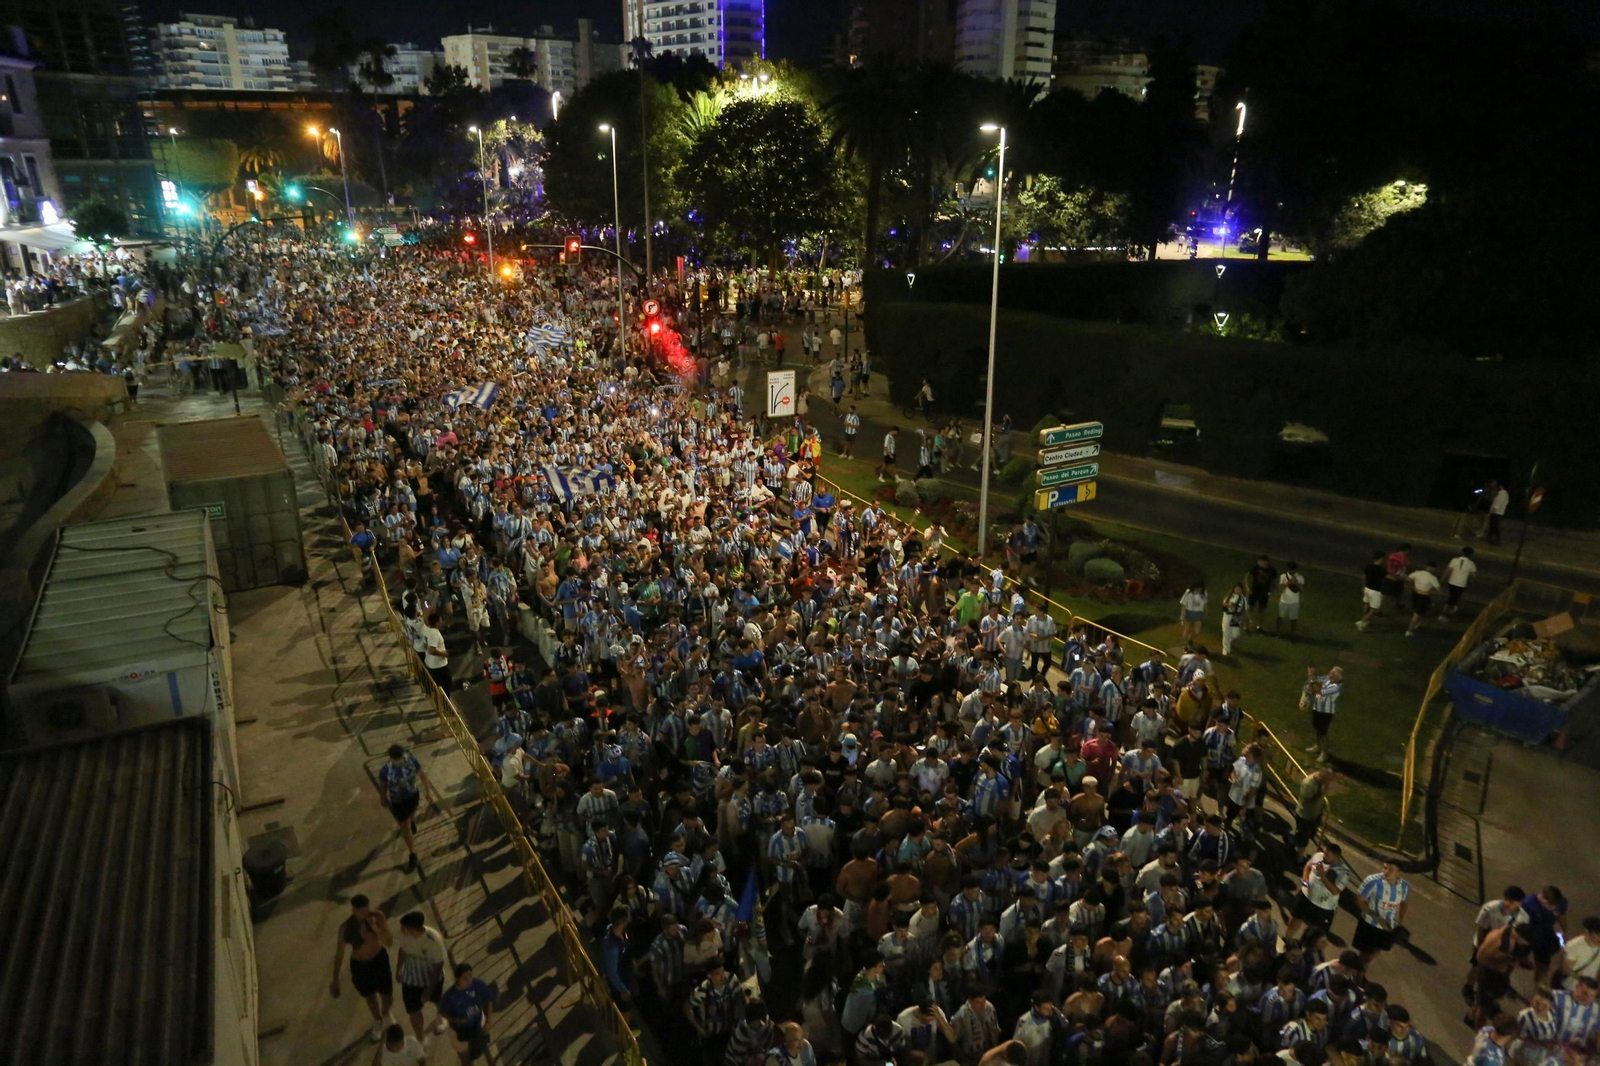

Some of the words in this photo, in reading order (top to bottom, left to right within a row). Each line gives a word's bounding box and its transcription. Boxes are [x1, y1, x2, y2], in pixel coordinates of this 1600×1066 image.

[1083, 428, 1102, 436] Reding
[1045, 454, 1063, 462] Centro
[1065, 450, 1083, 459] Ciudad
[1043, 473, 1059, 481] Paseo
[1071, 468, 1089, 477] Parque
[1048, 490, 1059, 508] P
